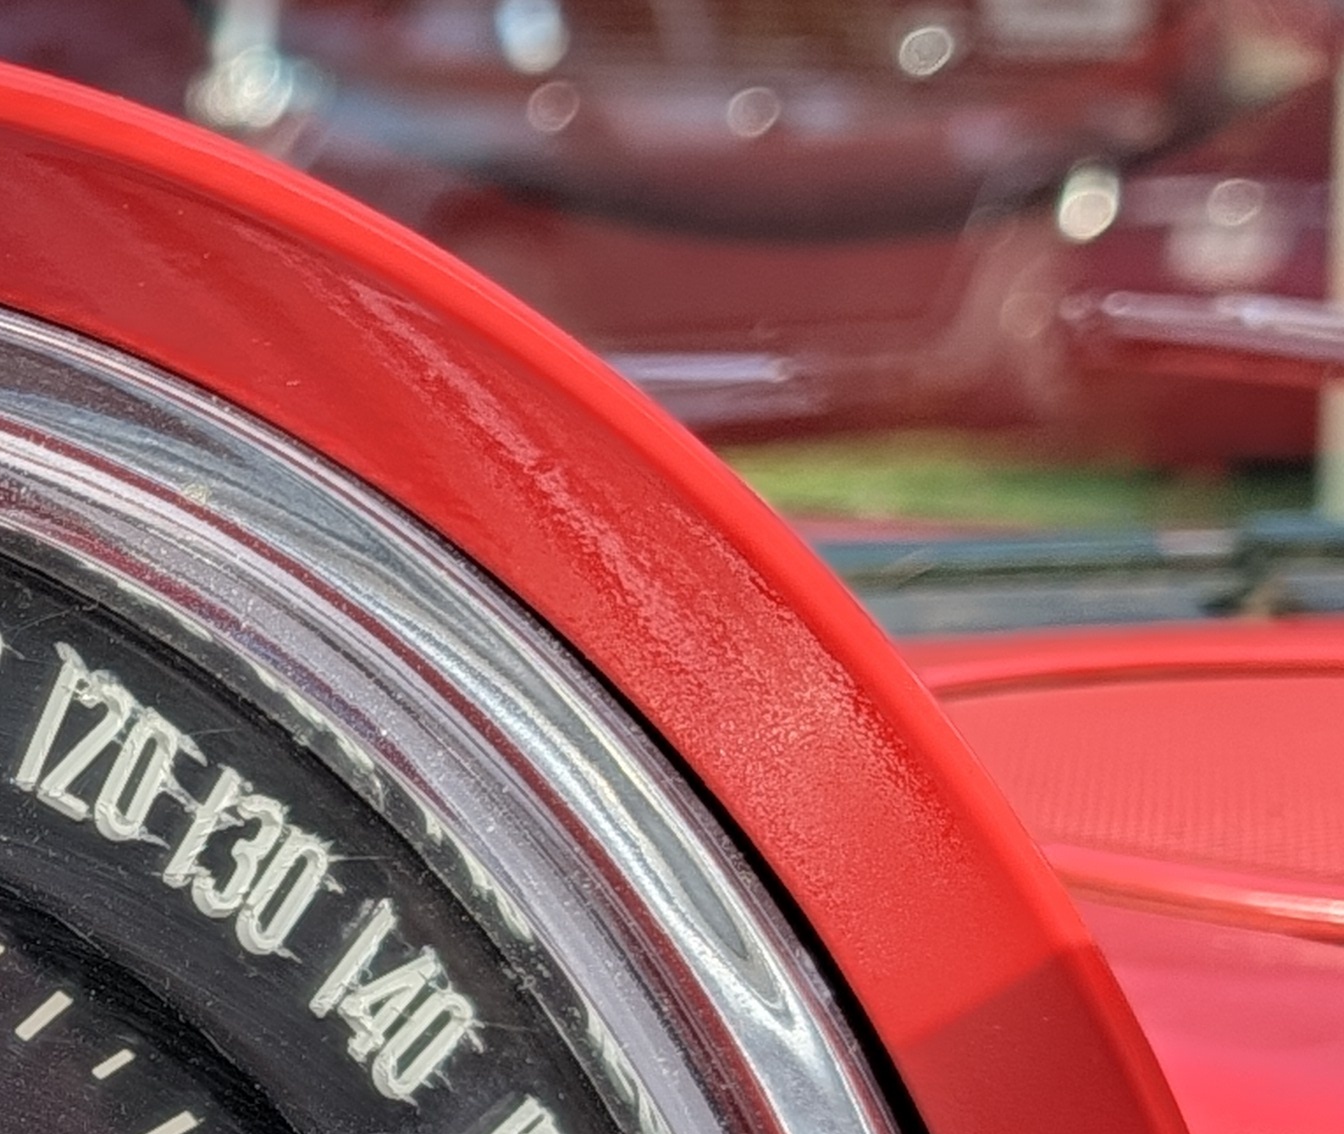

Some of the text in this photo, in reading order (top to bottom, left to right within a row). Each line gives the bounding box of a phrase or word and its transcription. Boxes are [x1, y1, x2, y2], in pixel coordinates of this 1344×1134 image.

[13, 645, 187, 841] 120
[163, 766, 331, 955] 130
[312, 899, 476, 1101] 140
